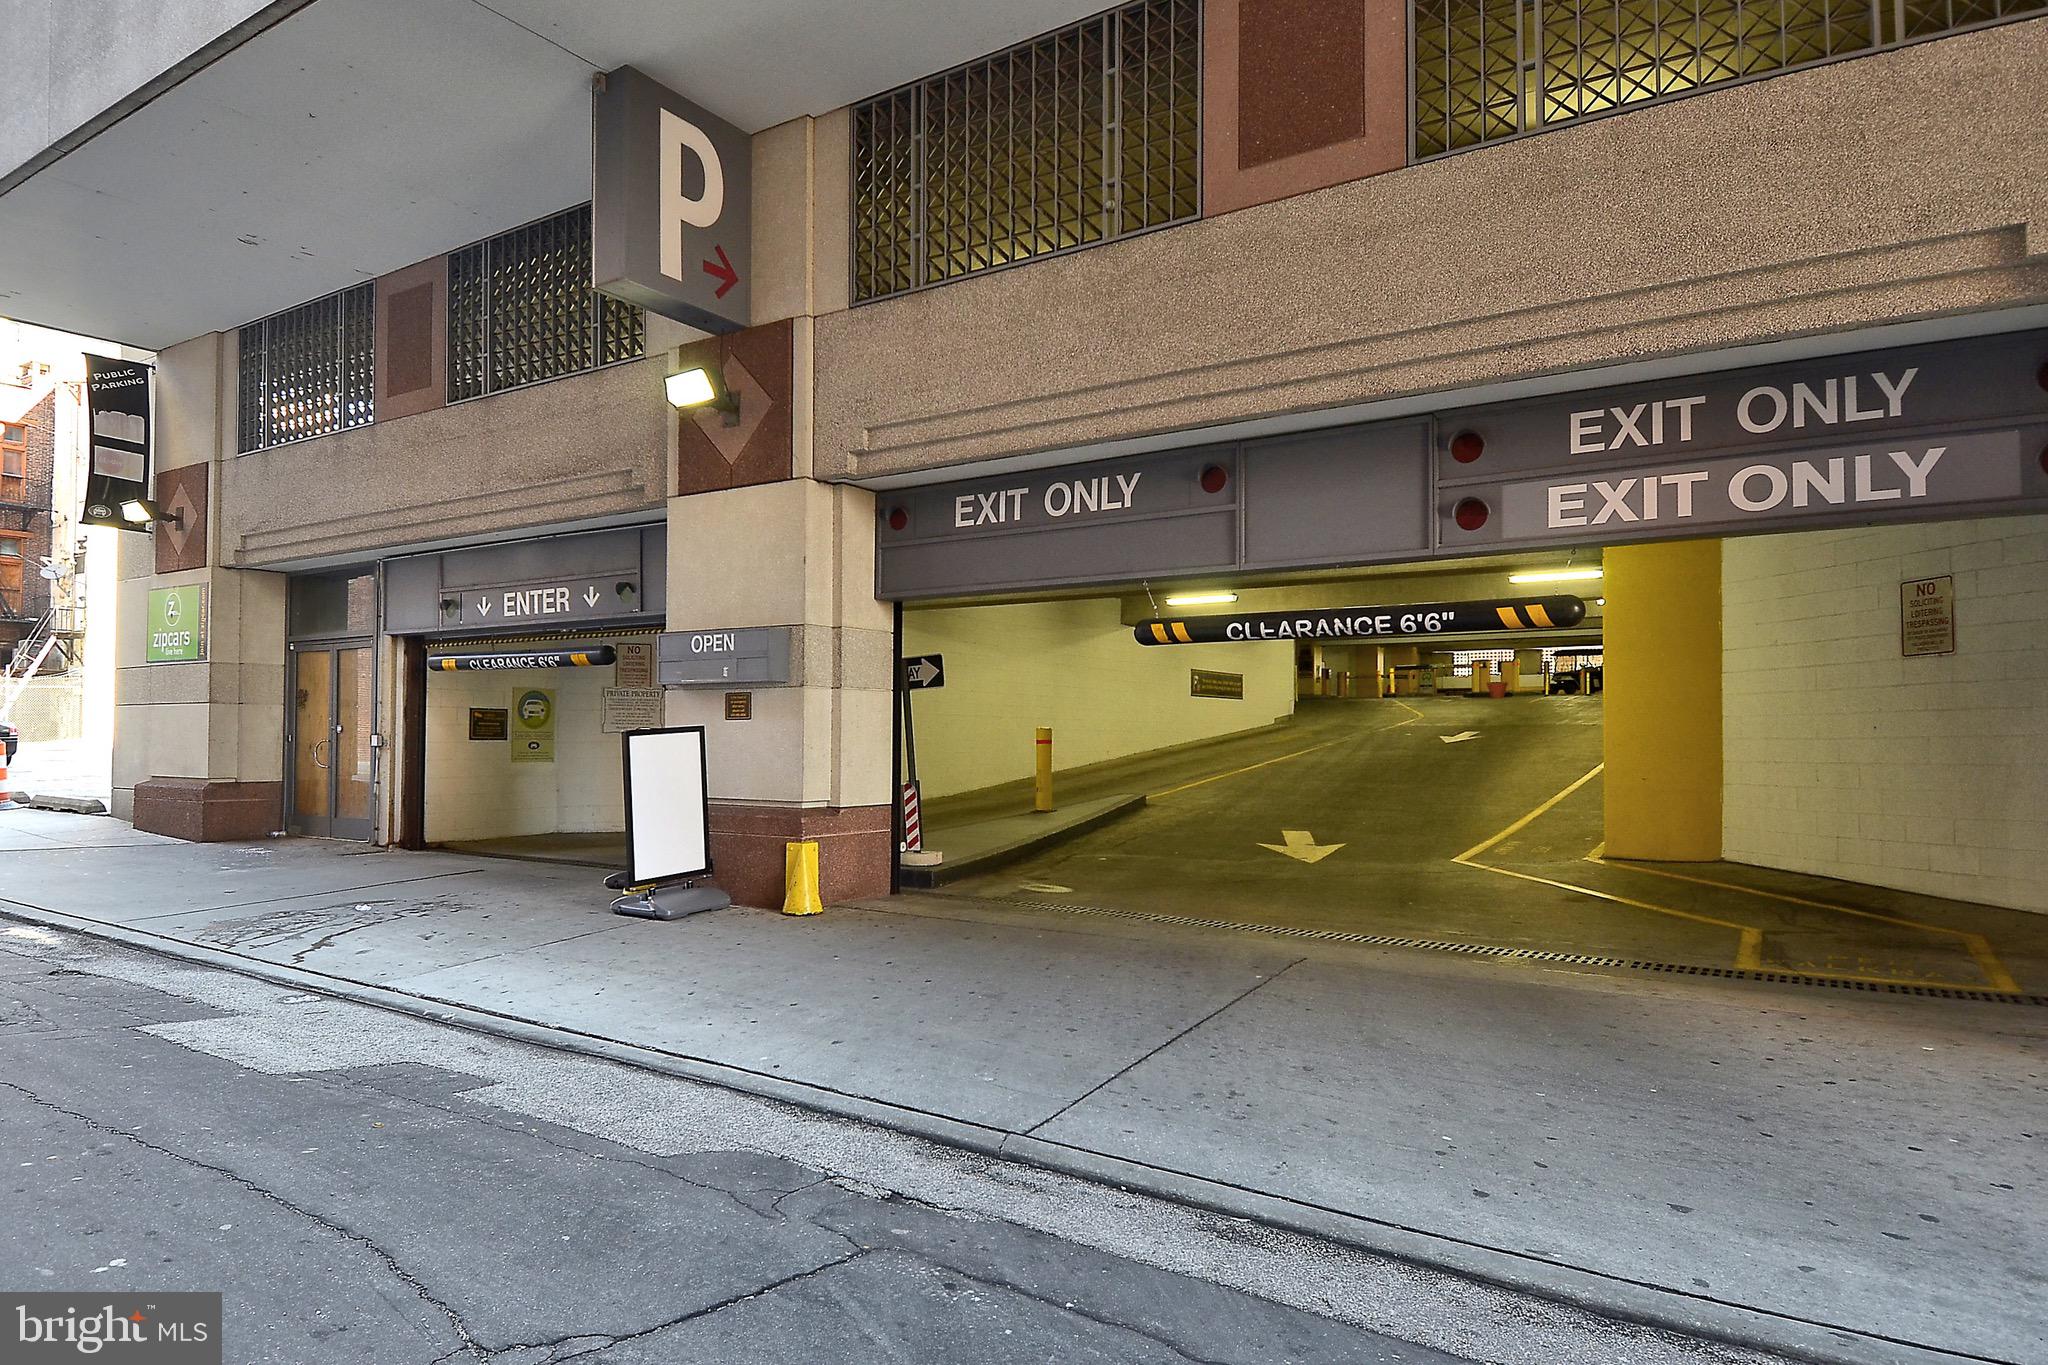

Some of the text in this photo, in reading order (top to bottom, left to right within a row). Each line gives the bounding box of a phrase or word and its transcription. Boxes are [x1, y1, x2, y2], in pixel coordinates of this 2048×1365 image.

[660, 107, 724, 282] P
[91, 377, 145, 392] PARKING
[93, 369, 136, 381] PUBLIC
[1569, 367, 1919, 455] EXIT ONLY
[954, 472, 1142, 528] EXIT ONLY
[1547, 446, 1946, 529] EXIT ONLY
[503, 587, 570, 617] ENTER
[1916, 582, 1936, 597] NO
[1225, 611, 1455, 640] CLEARANCE 6'6"
[153, 628, 191, 653] zipcars
[627, 645, 641, 655] NO
[690, 633, 735, 653] OPEN
[469, 655, 535, 671] CLEARANCE
